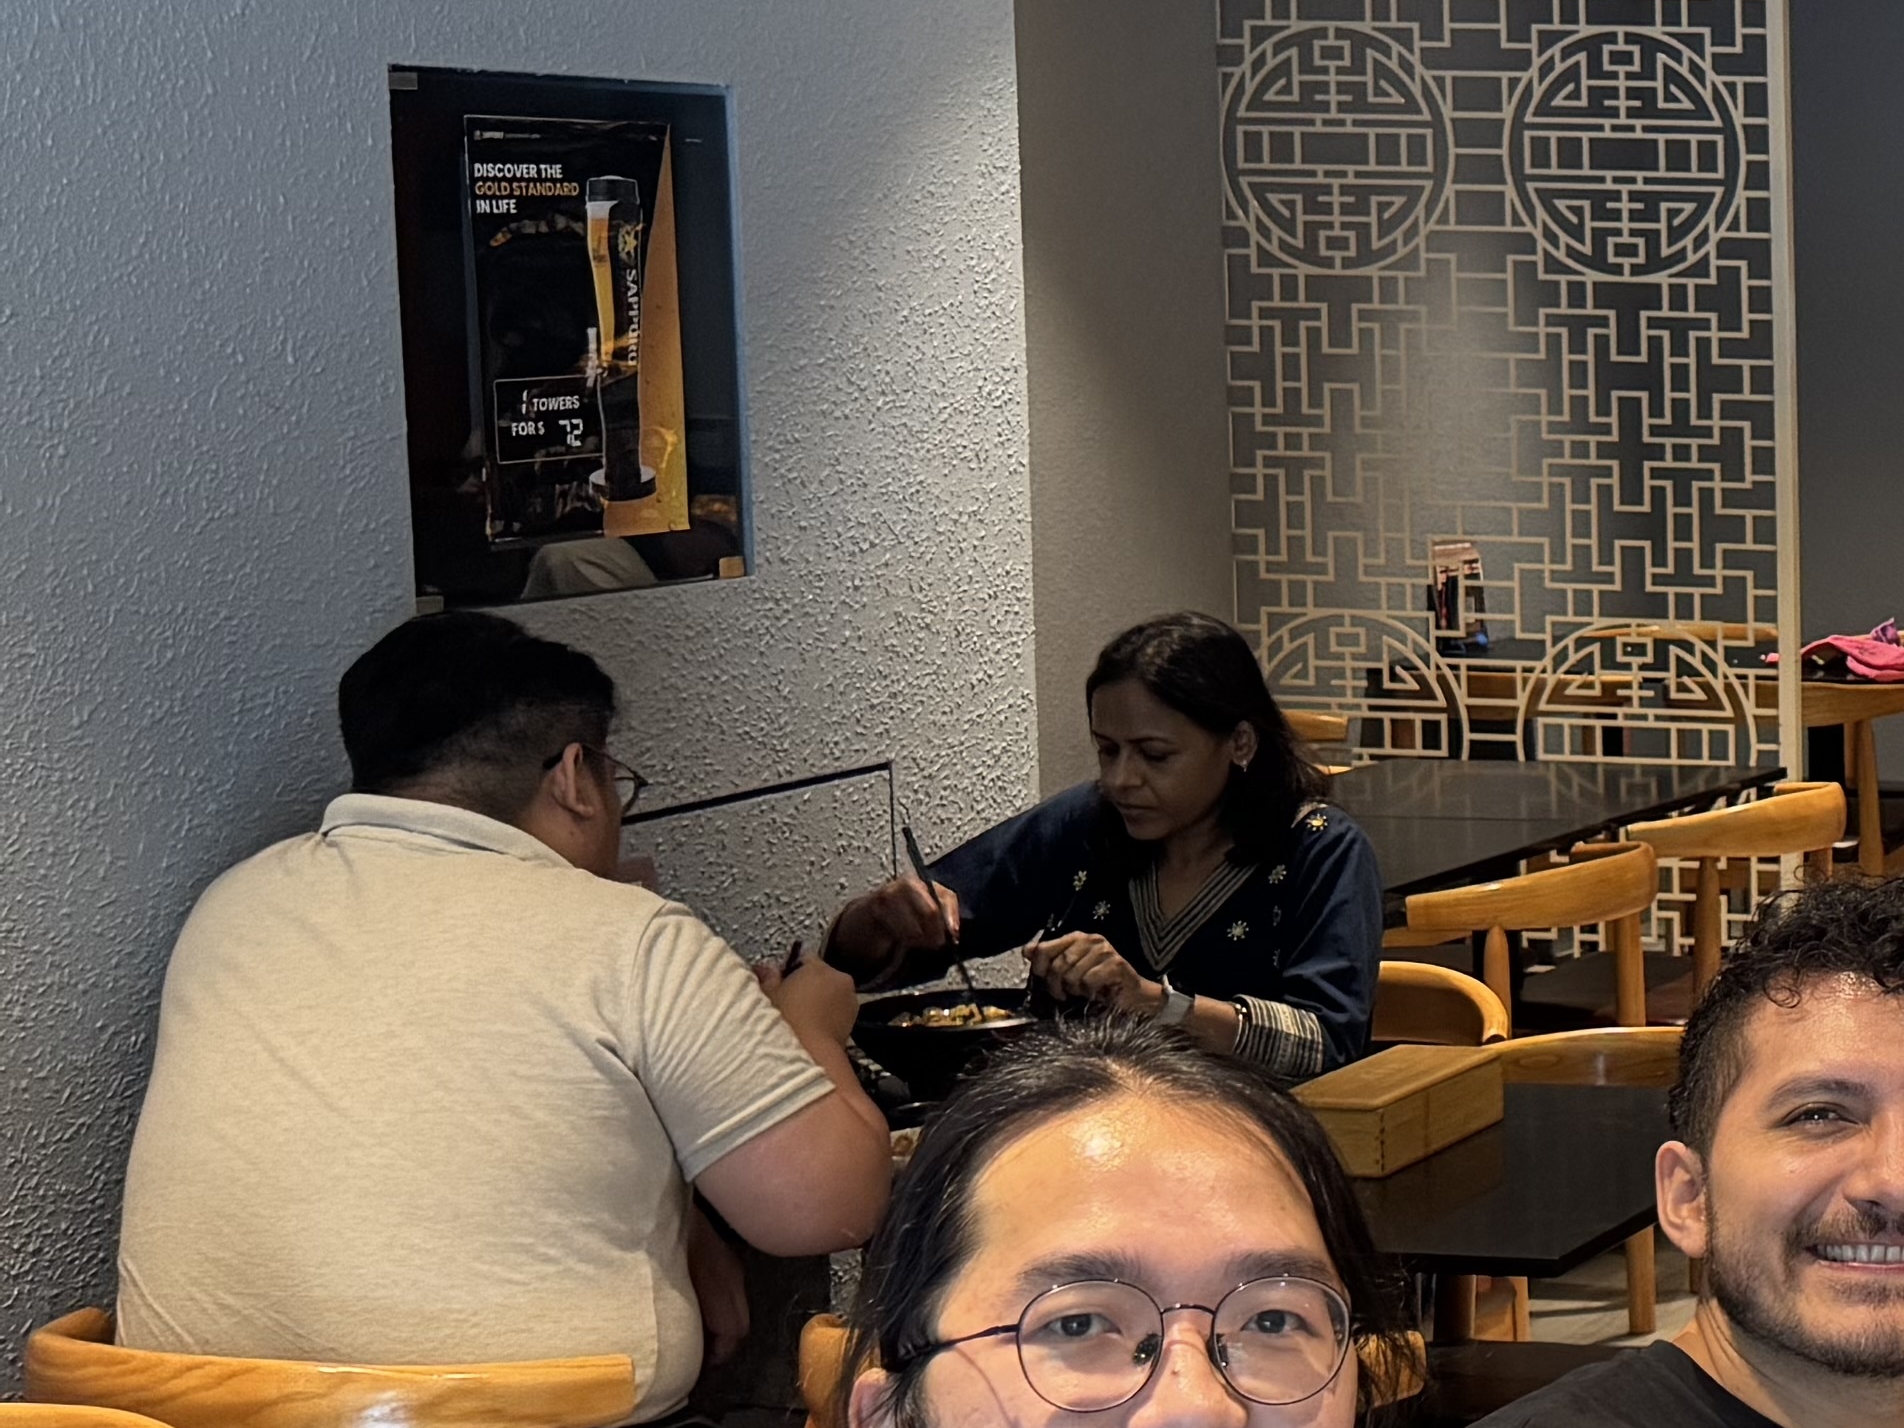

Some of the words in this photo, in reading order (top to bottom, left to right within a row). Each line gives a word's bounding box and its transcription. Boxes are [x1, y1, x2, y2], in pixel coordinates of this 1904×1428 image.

[474, 163, 538, 178] DISCOVER
[539, 164, 563, 178] THE
[475, 181, 510, 195] GOLD
[513, 182, 580, 196] STANDARD
[476, 199, 490, 214] IN
[492, 199, 517, 213] LIFE
[532, 395, 580, 412] TOWERS
[511, 421, 536, 436] FOR
